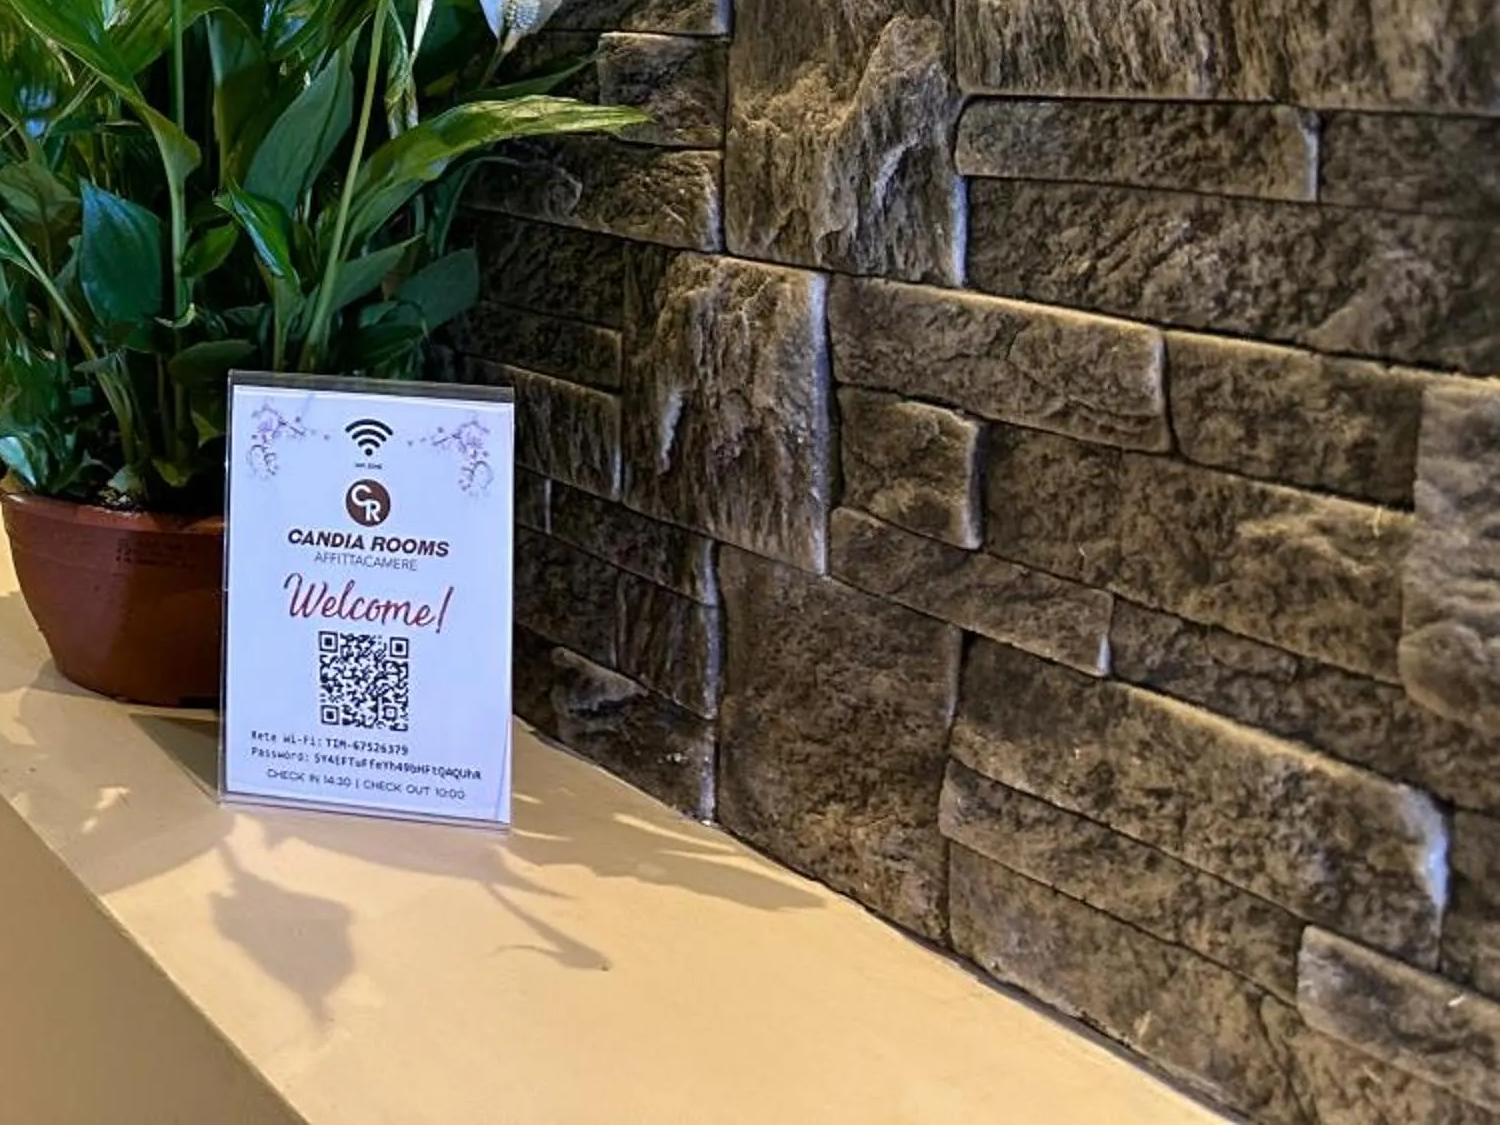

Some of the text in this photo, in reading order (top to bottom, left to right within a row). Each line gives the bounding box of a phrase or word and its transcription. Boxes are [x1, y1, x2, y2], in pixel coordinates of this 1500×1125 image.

[288, 528, 450, 558] CANDIA ROOMS
[313, 550, 418, 572] AFFITTACAMERE
[284, 572, 454, 634] Welcome!
[251, 746, 309, 763] Password:
[363, 779, 403, 793] CHECK
[405, 783, 431, 796] OUT
